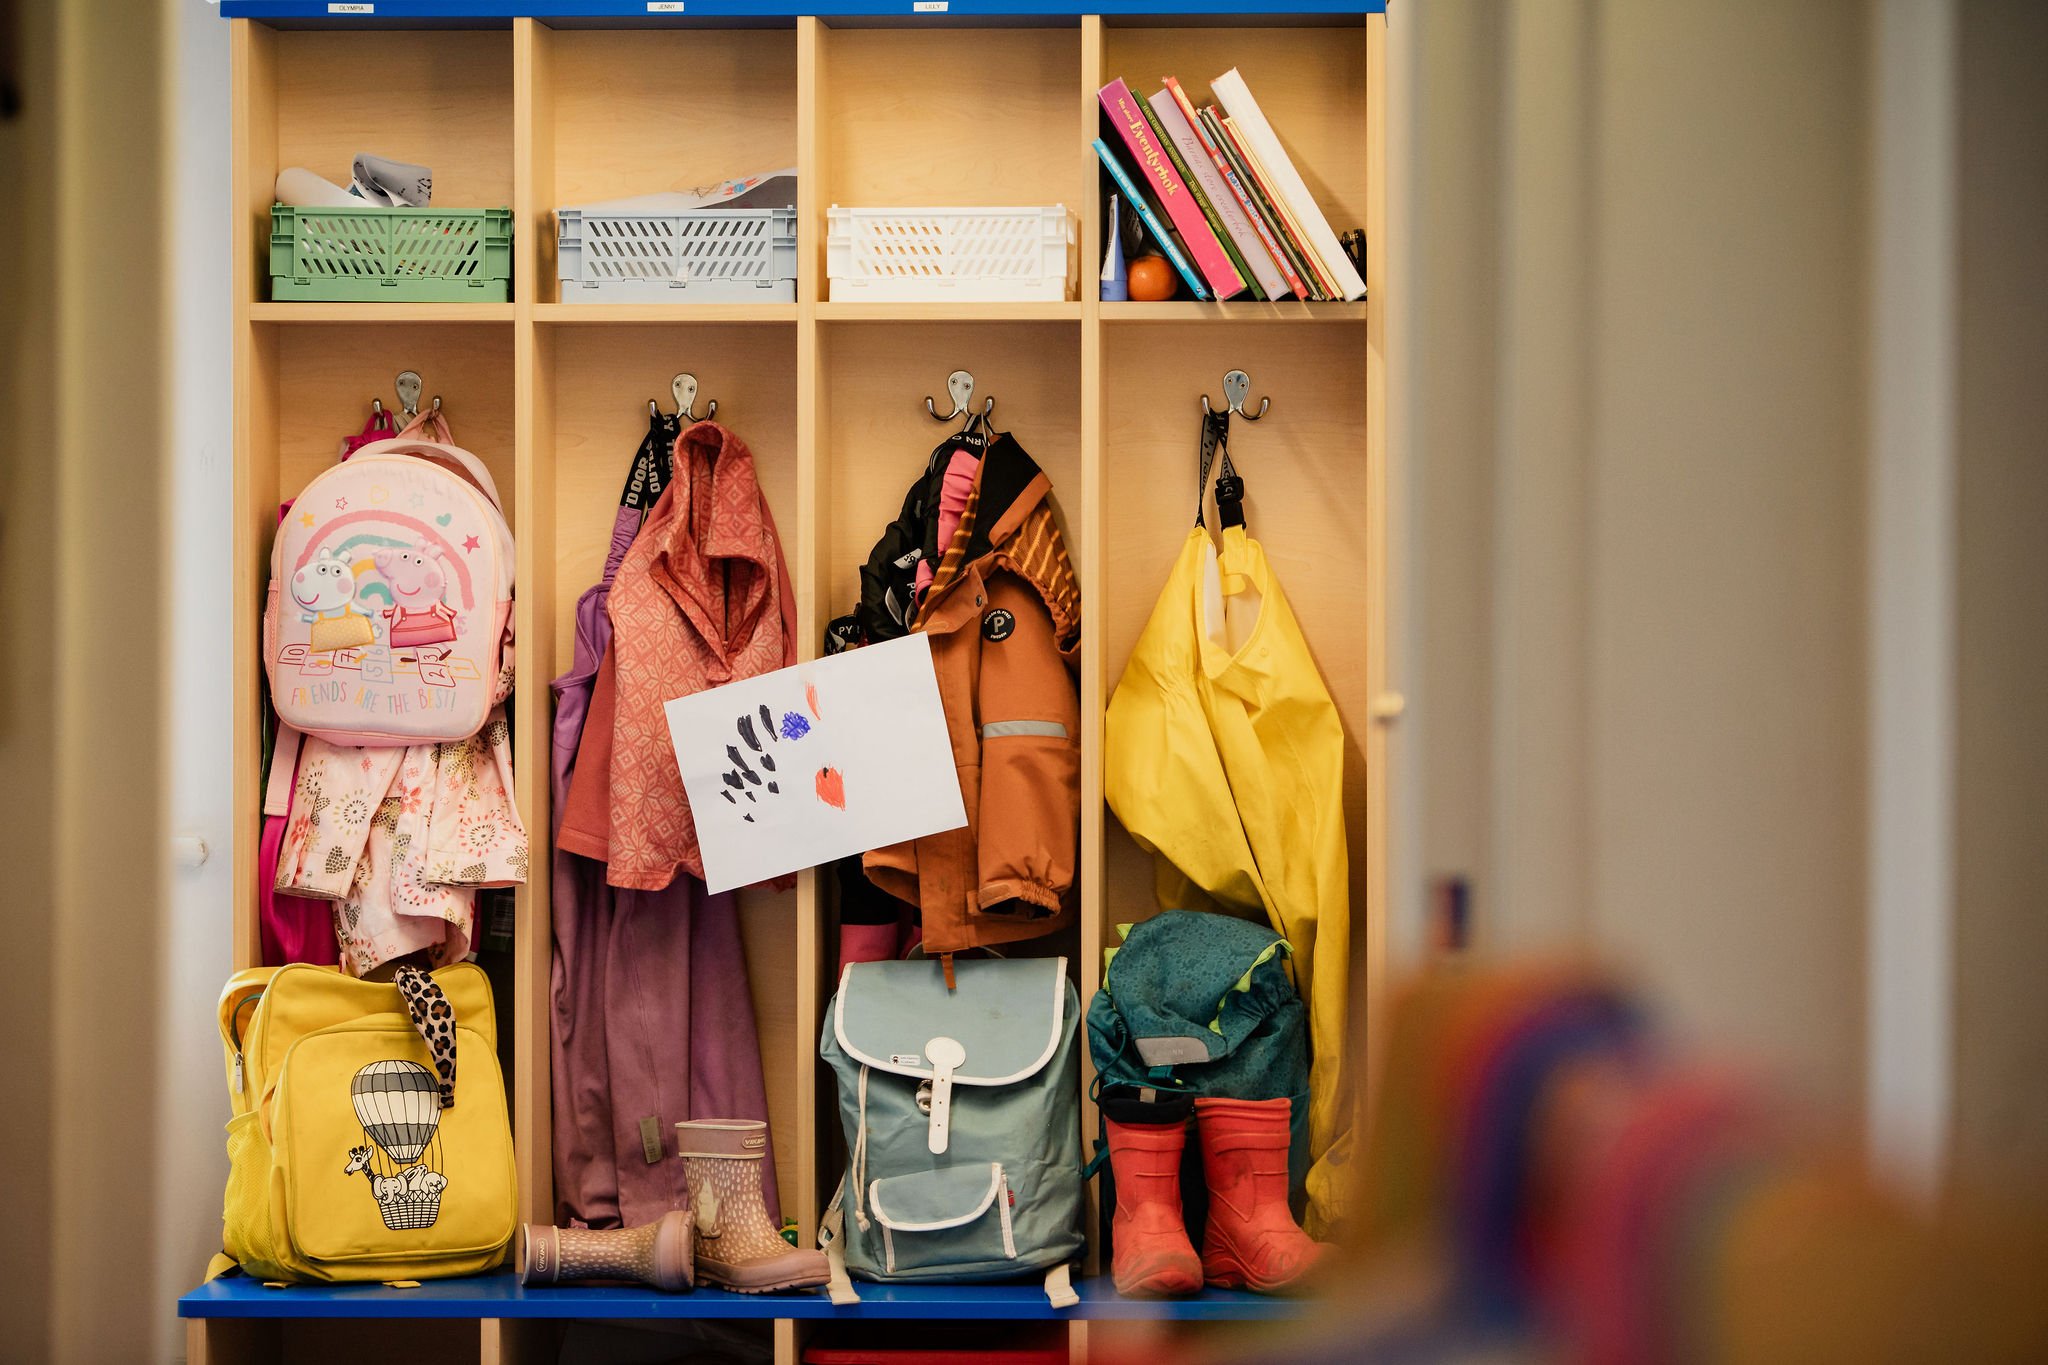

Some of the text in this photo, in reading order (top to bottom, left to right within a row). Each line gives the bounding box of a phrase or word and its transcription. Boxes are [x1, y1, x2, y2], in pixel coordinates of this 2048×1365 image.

[1129, 119, 1178, 196] Eventyrbok
[994, 616, 1005, 633] P
[291, 681, 456, 716] FRIENDS ARE THE BEST!
[538, 1240, 546, 1269] VIKING
